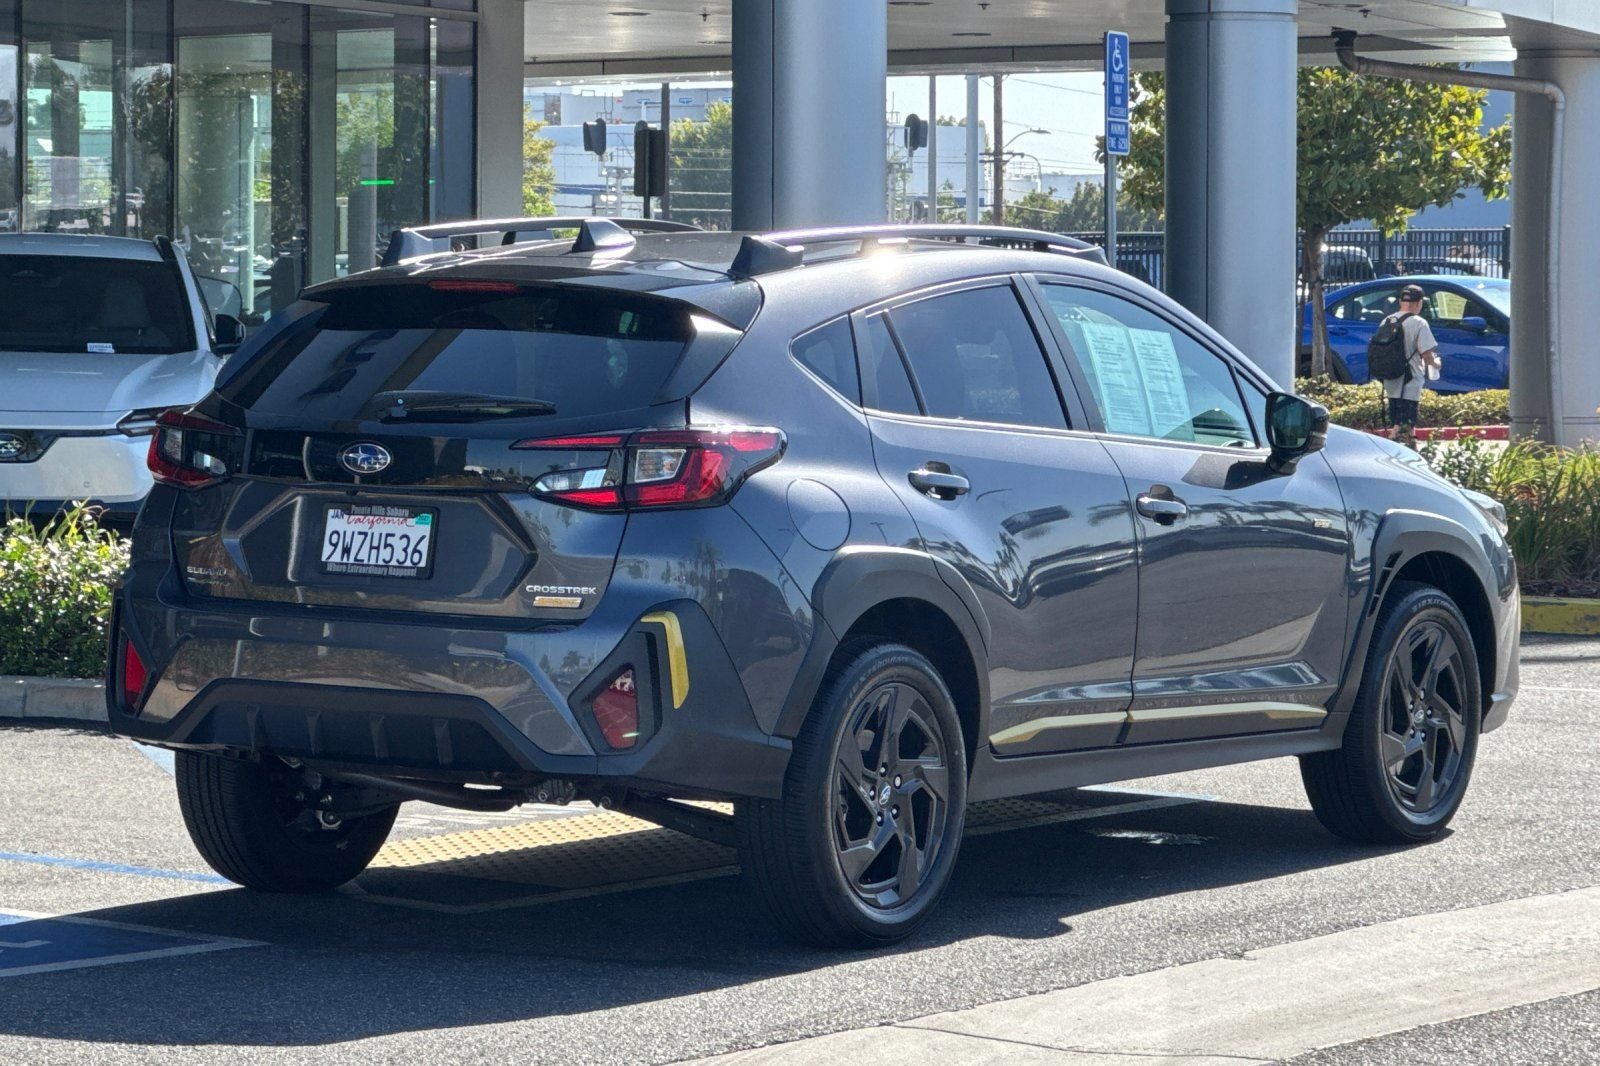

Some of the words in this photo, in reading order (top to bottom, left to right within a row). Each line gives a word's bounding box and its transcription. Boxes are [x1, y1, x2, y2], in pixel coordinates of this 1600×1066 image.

[331, 511, 344, 519] JAN
[346, 514, 415, 530] California
[325, 530, 427, 566] 9WZH536
[525, 584, 597, 595] CROSSTREK
